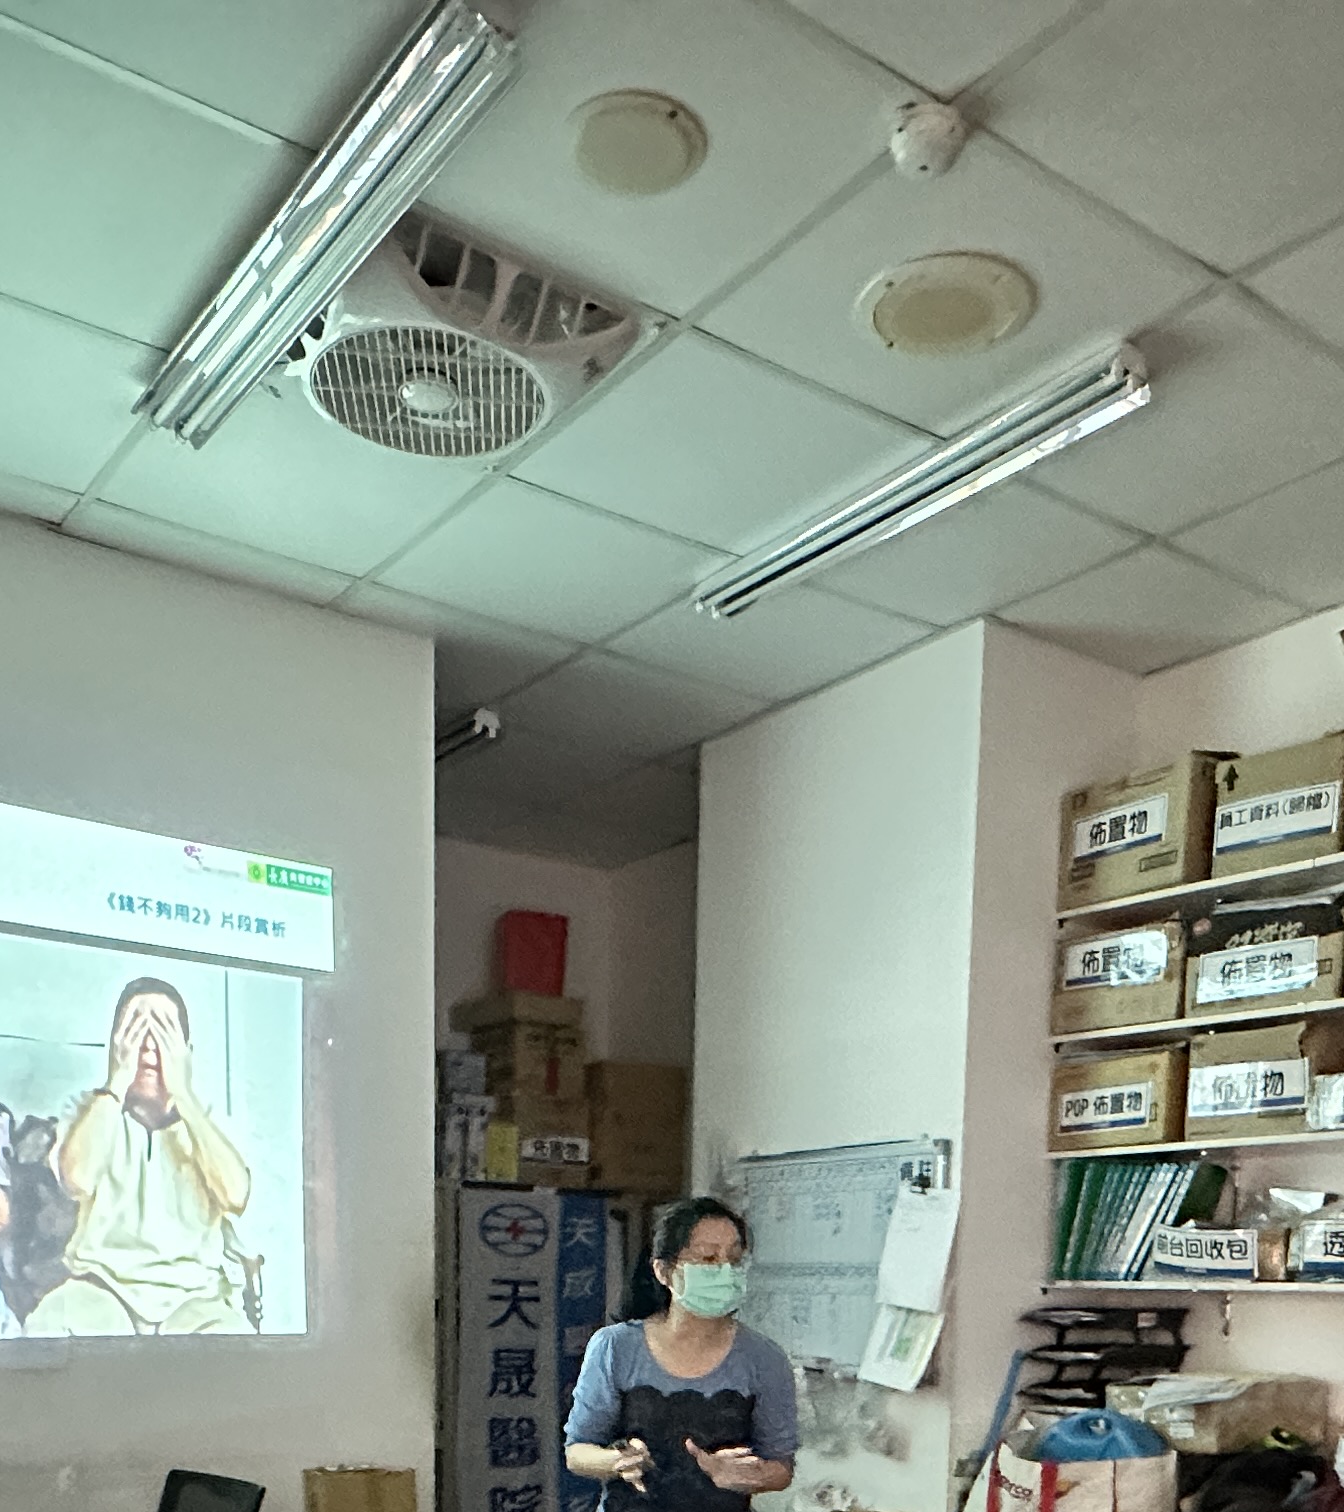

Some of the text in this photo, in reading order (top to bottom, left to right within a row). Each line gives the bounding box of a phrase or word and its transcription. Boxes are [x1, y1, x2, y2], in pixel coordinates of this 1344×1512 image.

[1088, 809, 1149, 849] 佈置物
[1064, 1090, 1143, 1118] POP 佈置物
